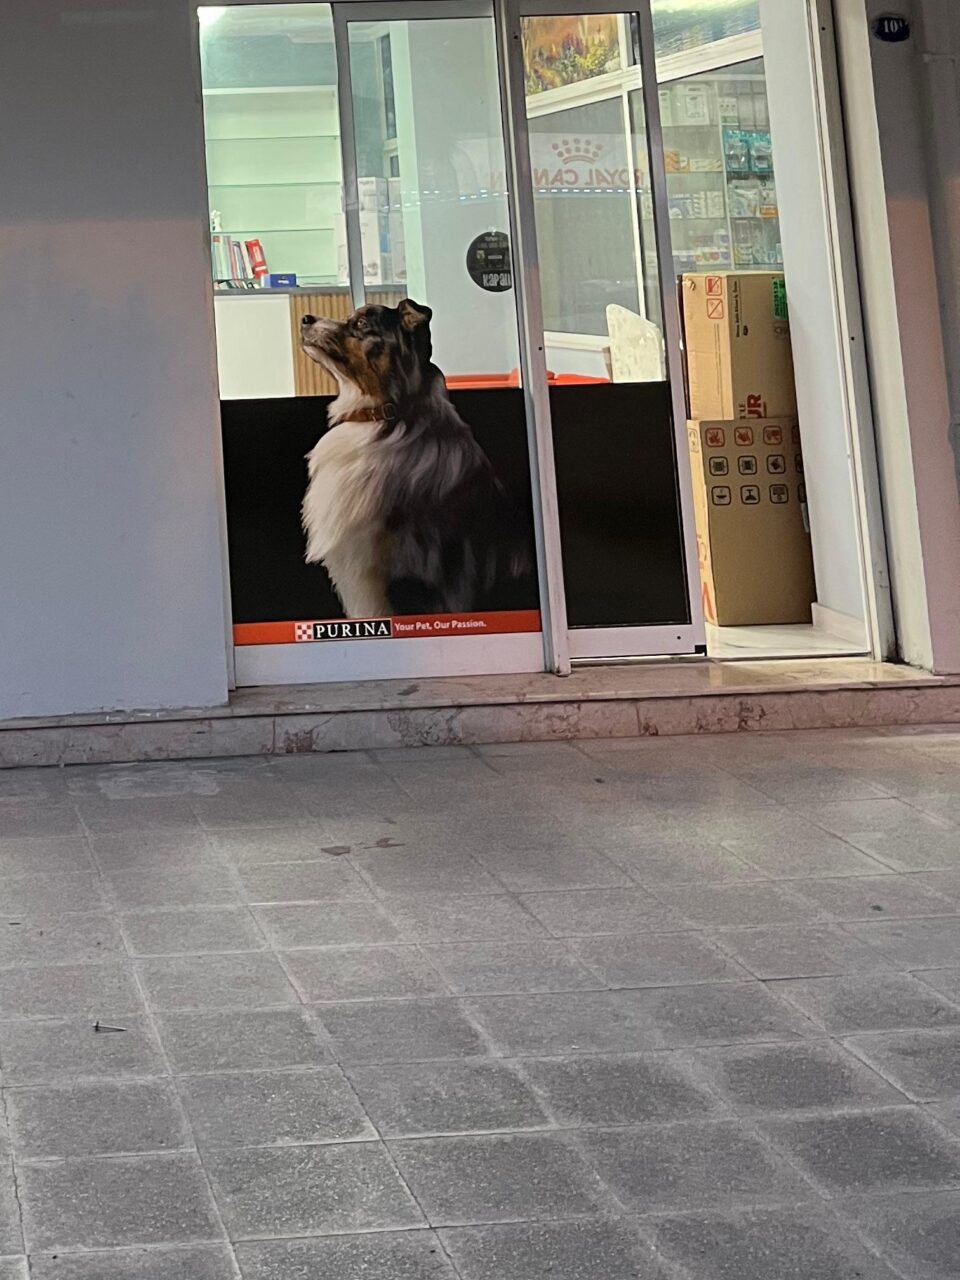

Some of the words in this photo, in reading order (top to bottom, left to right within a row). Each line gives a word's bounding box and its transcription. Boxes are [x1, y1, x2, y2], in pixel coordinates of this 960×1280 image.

[316, 622, 389, 639] PURINA
[395, 622, 415, 631] Your
[416, 621, 432, 630] Pet,
[433, 620, 450, 629] Our
[452, 619, 487, 628] Passion.
